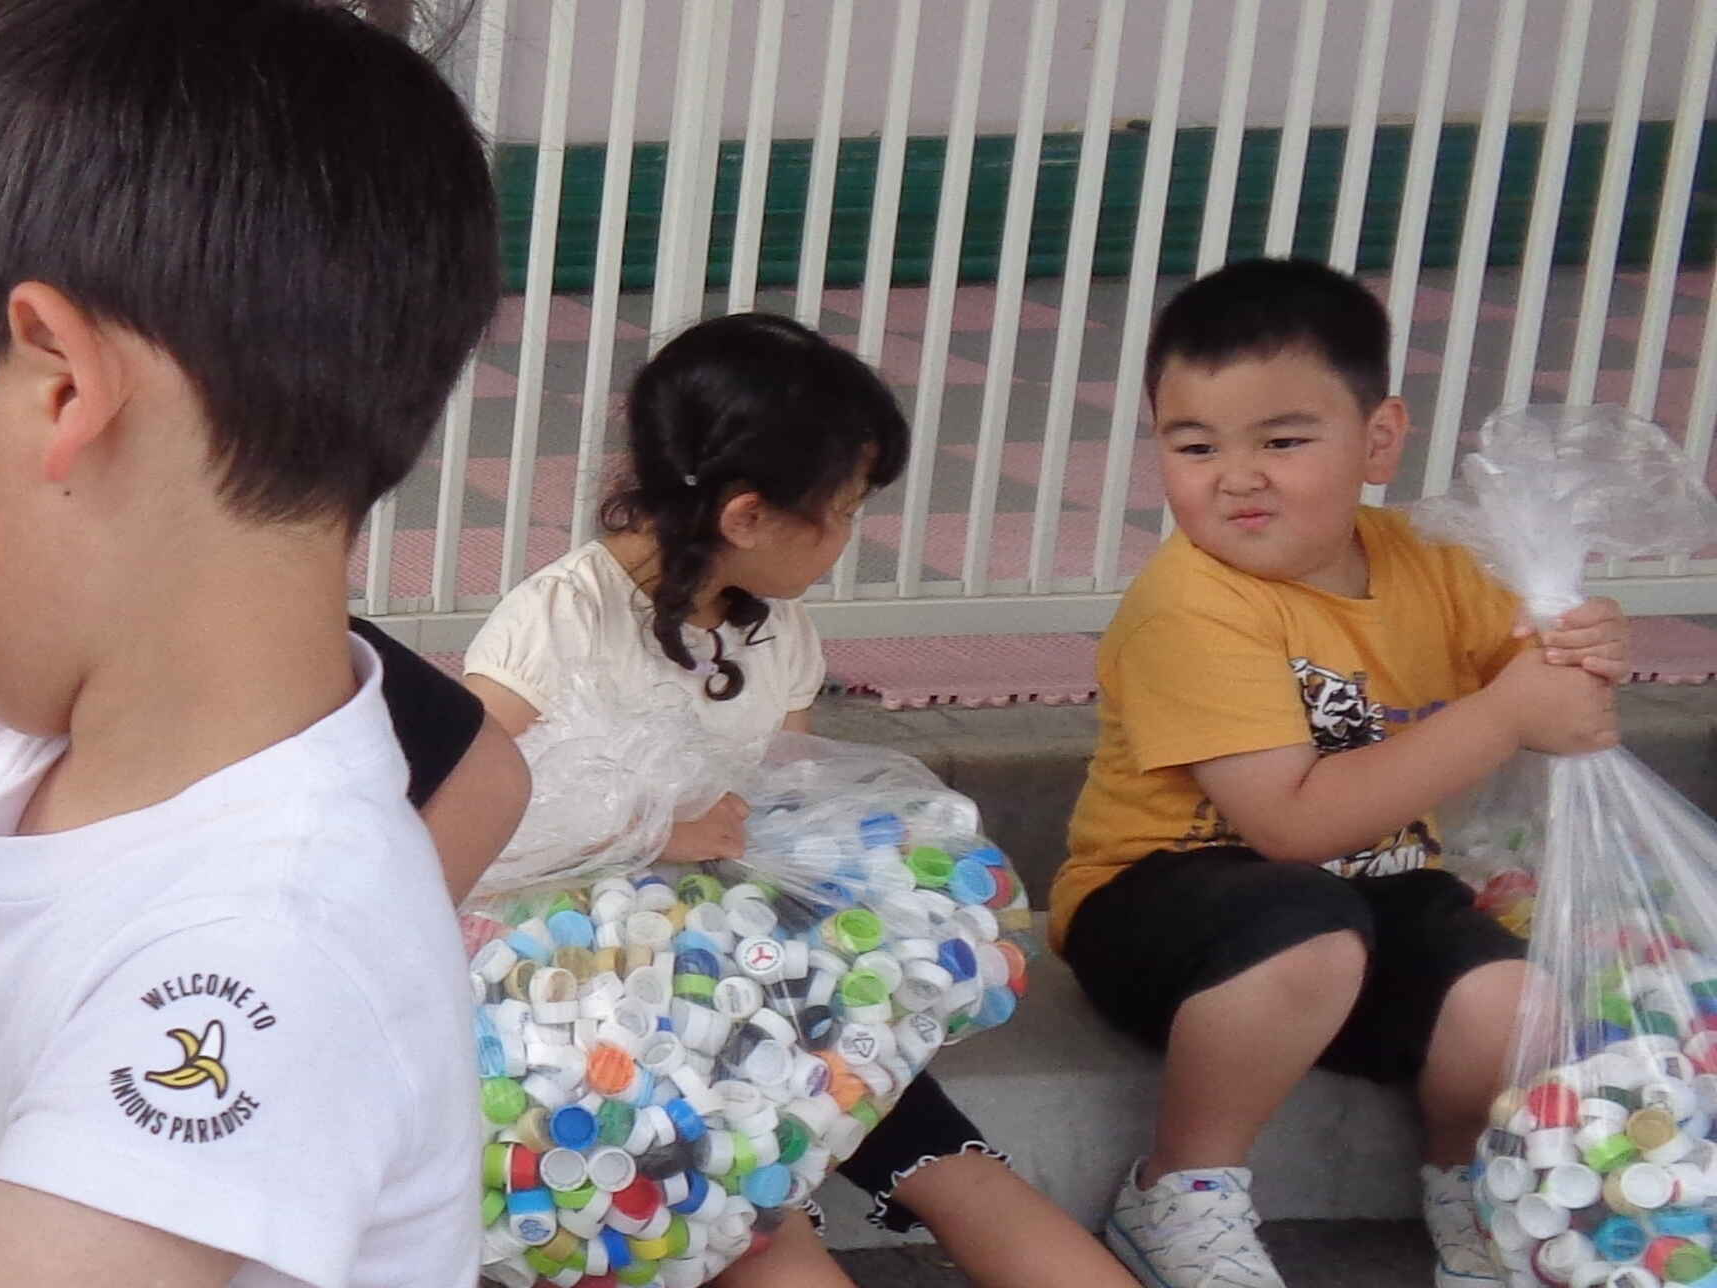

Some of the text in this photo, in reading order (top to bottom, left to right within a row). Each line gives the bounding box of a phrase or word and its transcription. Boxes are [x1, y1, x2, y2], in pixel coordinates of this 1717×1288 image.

[140, 972, 277, 1031] WELCOME TO
[109, 1066, 261, 1144] MINIONS PARADISE
